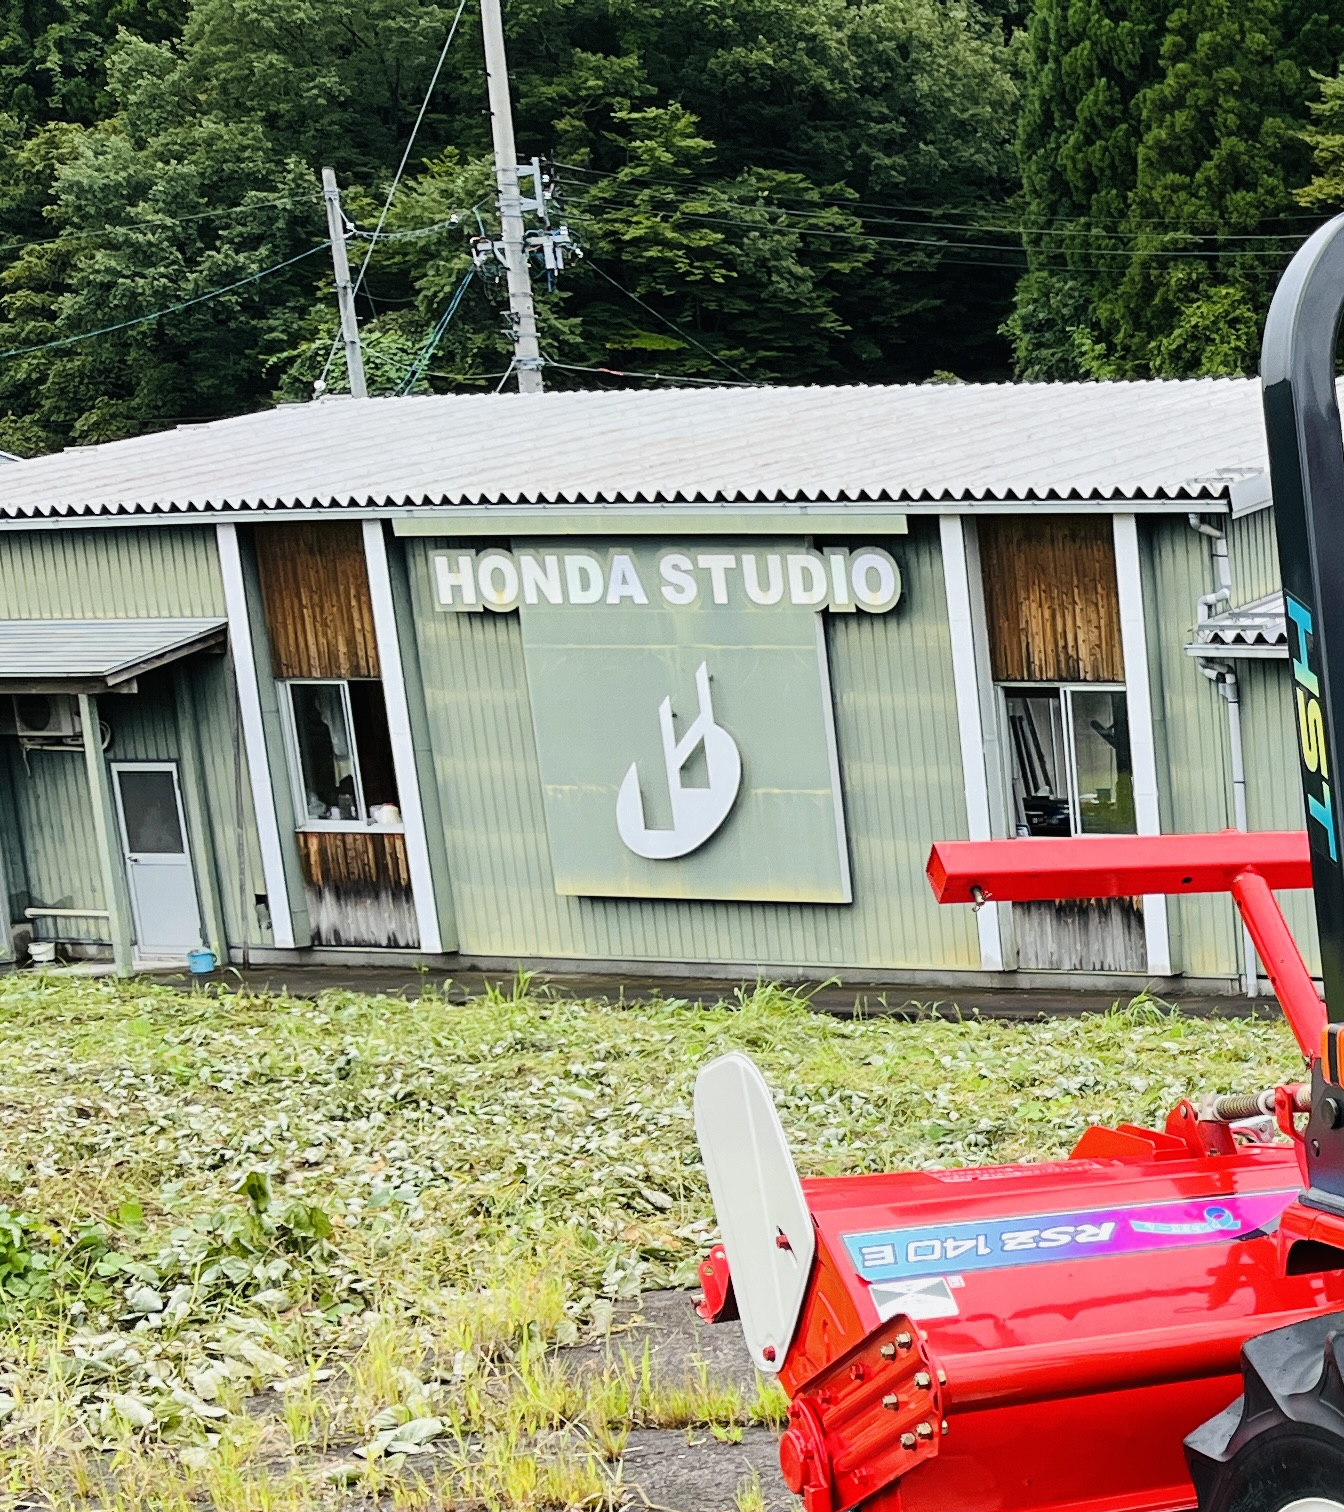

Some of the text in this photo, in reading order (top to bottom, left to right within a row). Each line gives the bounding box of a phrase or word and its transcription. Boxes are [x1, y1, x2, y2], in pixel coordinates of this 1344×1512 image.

[434, 552, 896, 606] HONDA STUDIO
[1286, 595, 1338, 864] HST
